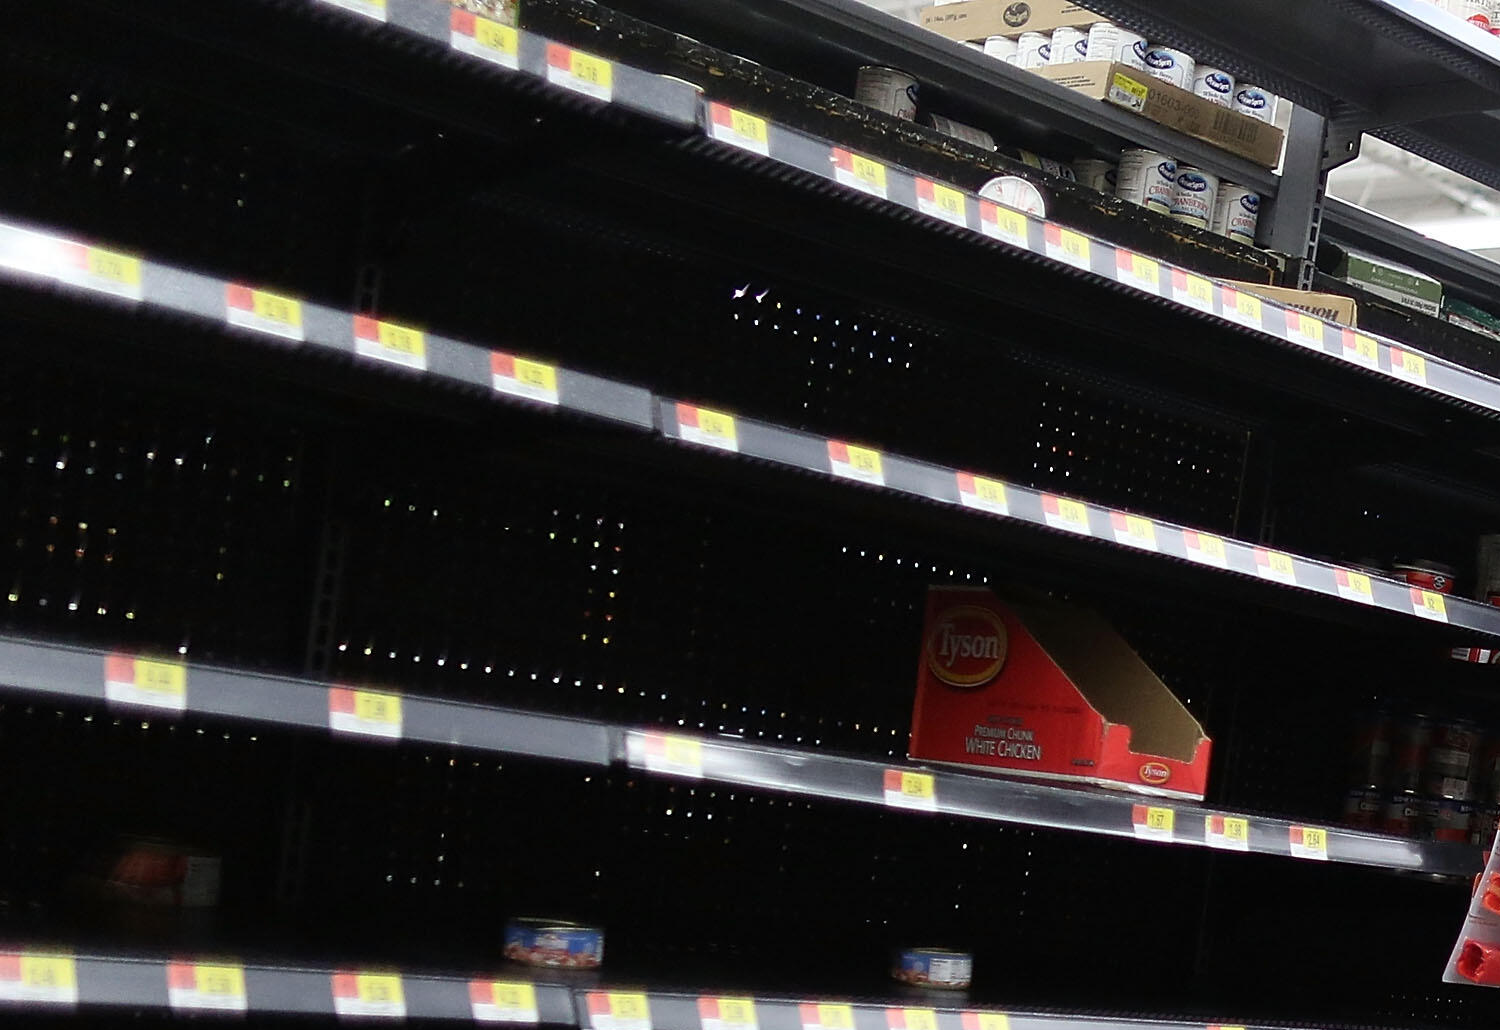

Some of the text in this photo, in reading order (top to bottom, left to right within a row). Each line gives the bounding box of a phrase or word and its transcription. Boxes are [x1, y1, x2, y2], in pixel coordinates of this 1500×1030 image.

[939, 621, 999, 666] Tyson
[965, 736, 1041, 761] WHITE CHICKEN
[1143, 765, 1168, 779] Tyson
